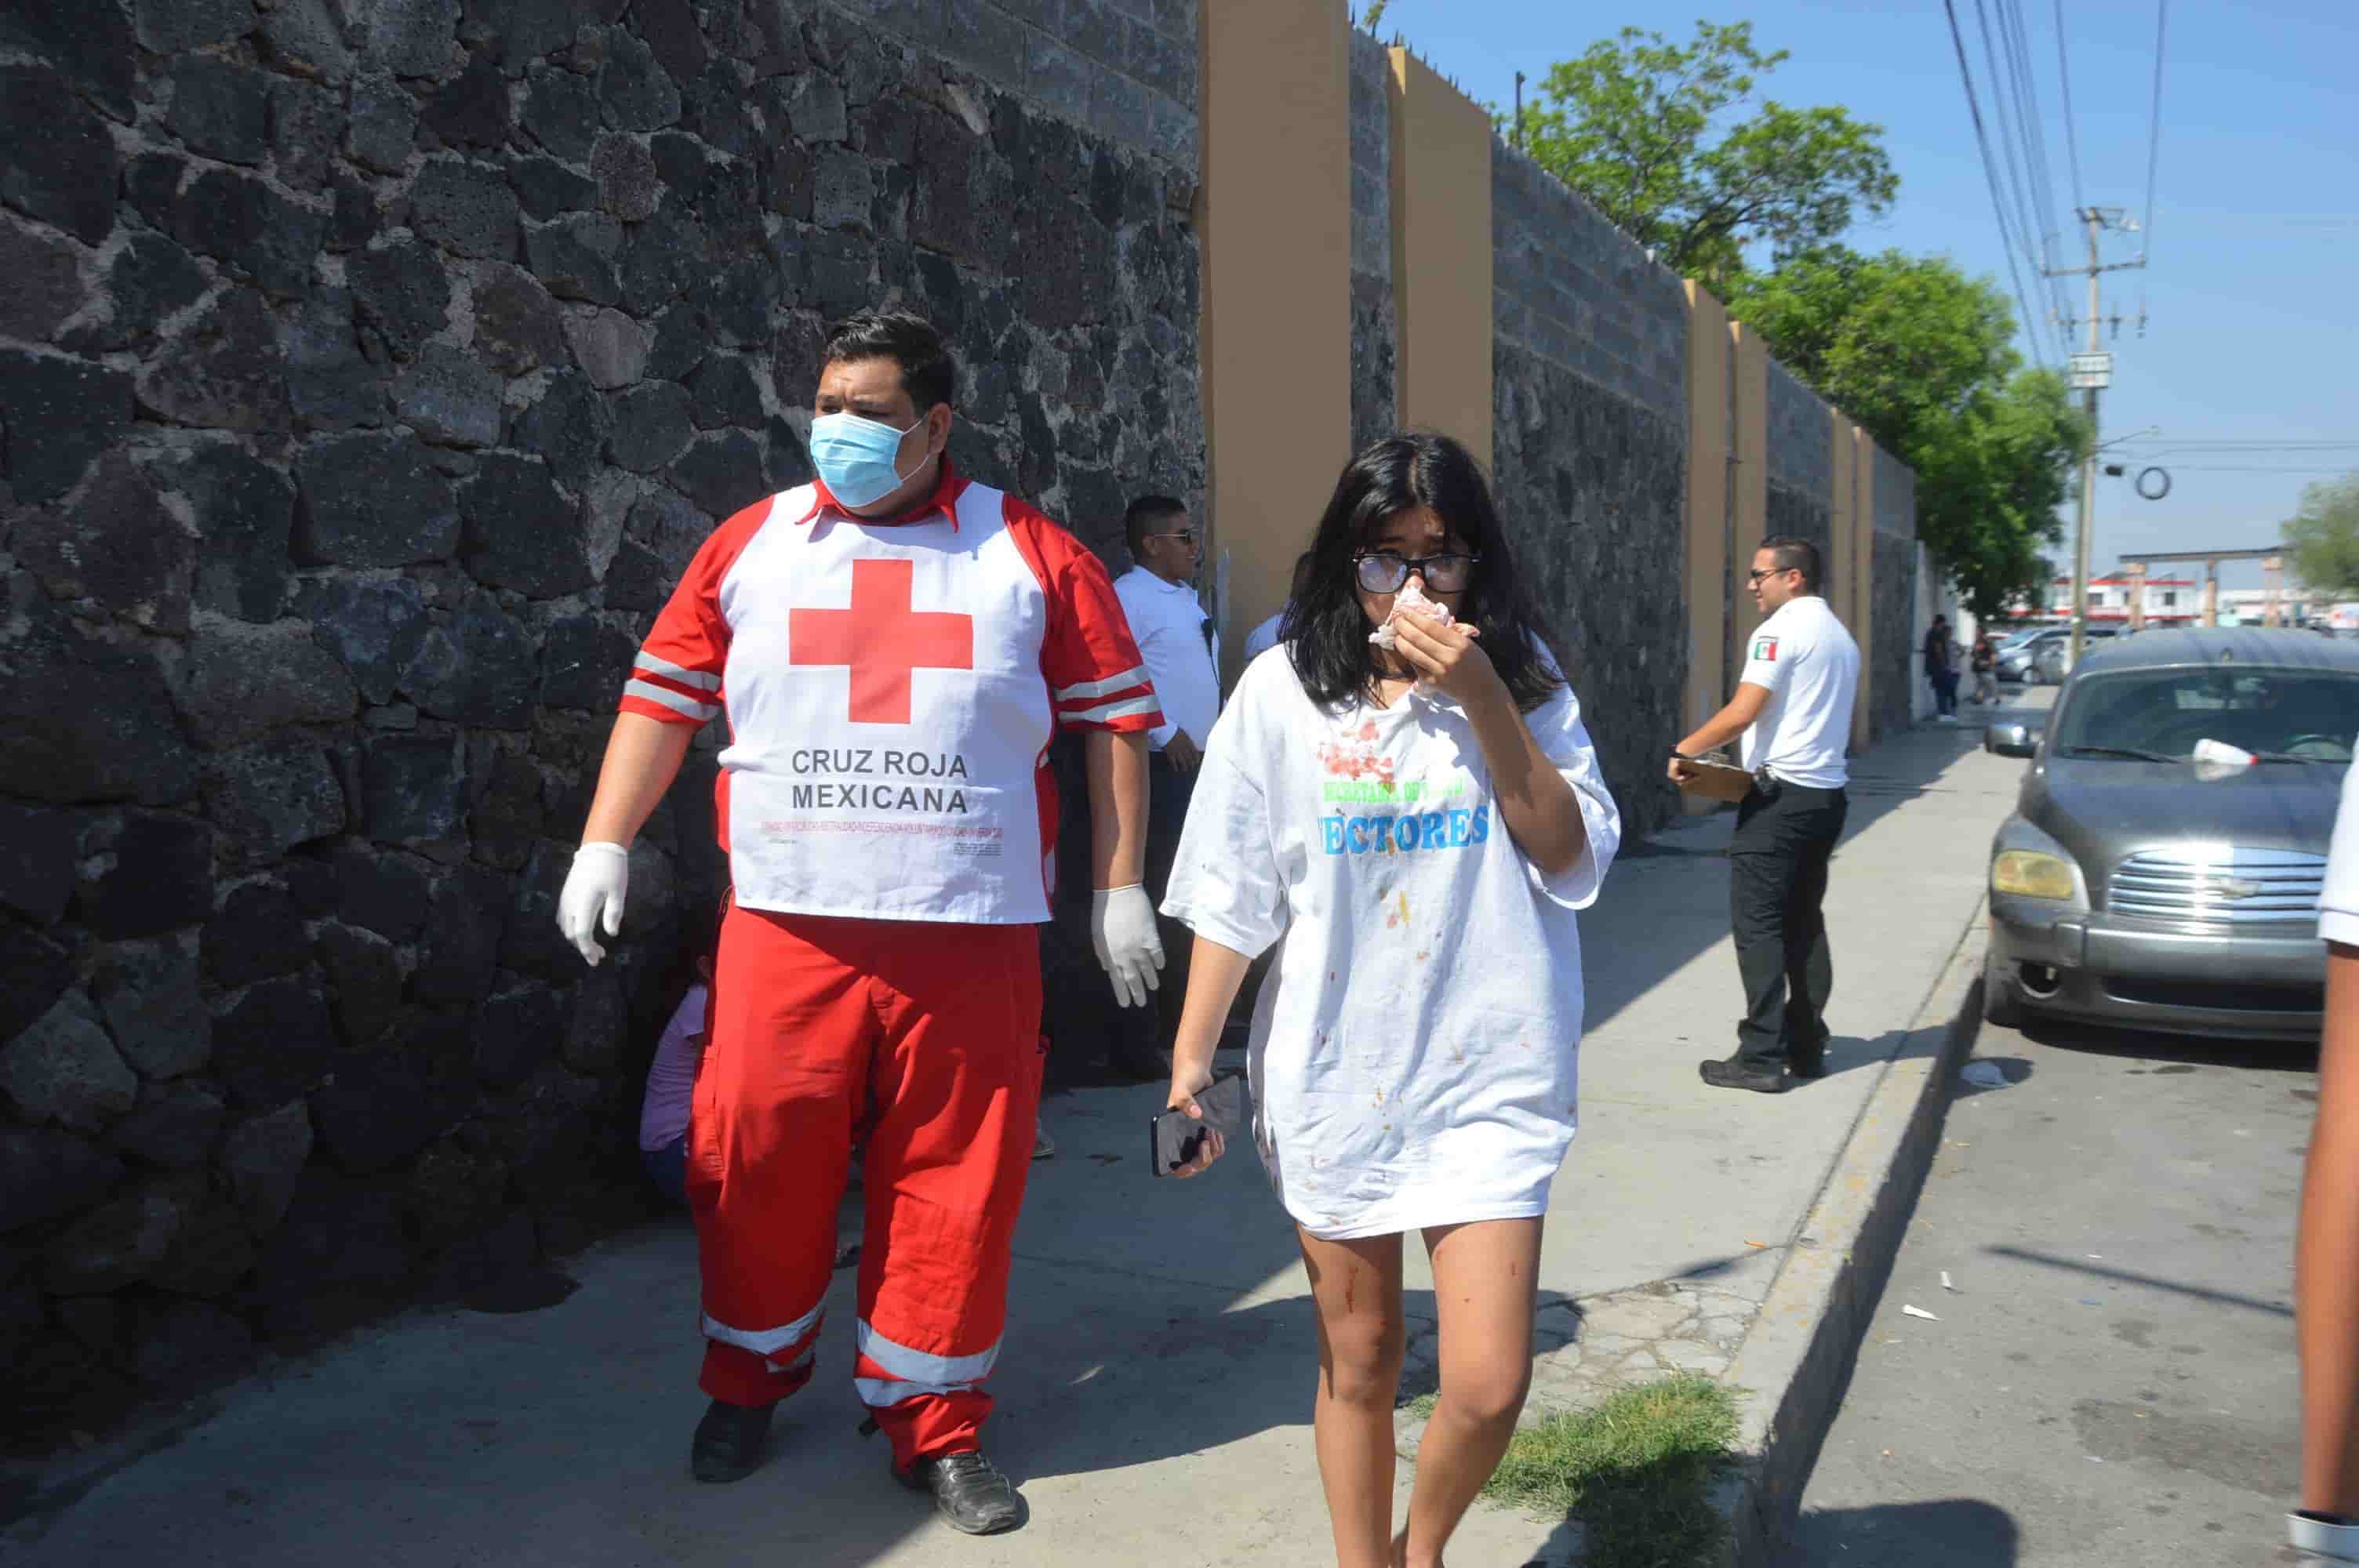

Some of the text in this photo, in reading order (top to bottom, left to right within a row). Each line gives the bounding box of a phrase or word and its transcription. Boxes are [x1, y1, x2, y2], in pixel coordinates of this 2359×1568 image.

[791, 749, 968, 779] CRUZ ROJA
[792, 784, 969, 814] MEXICANA
[1318, 804, 1488, 855] ECTORES
